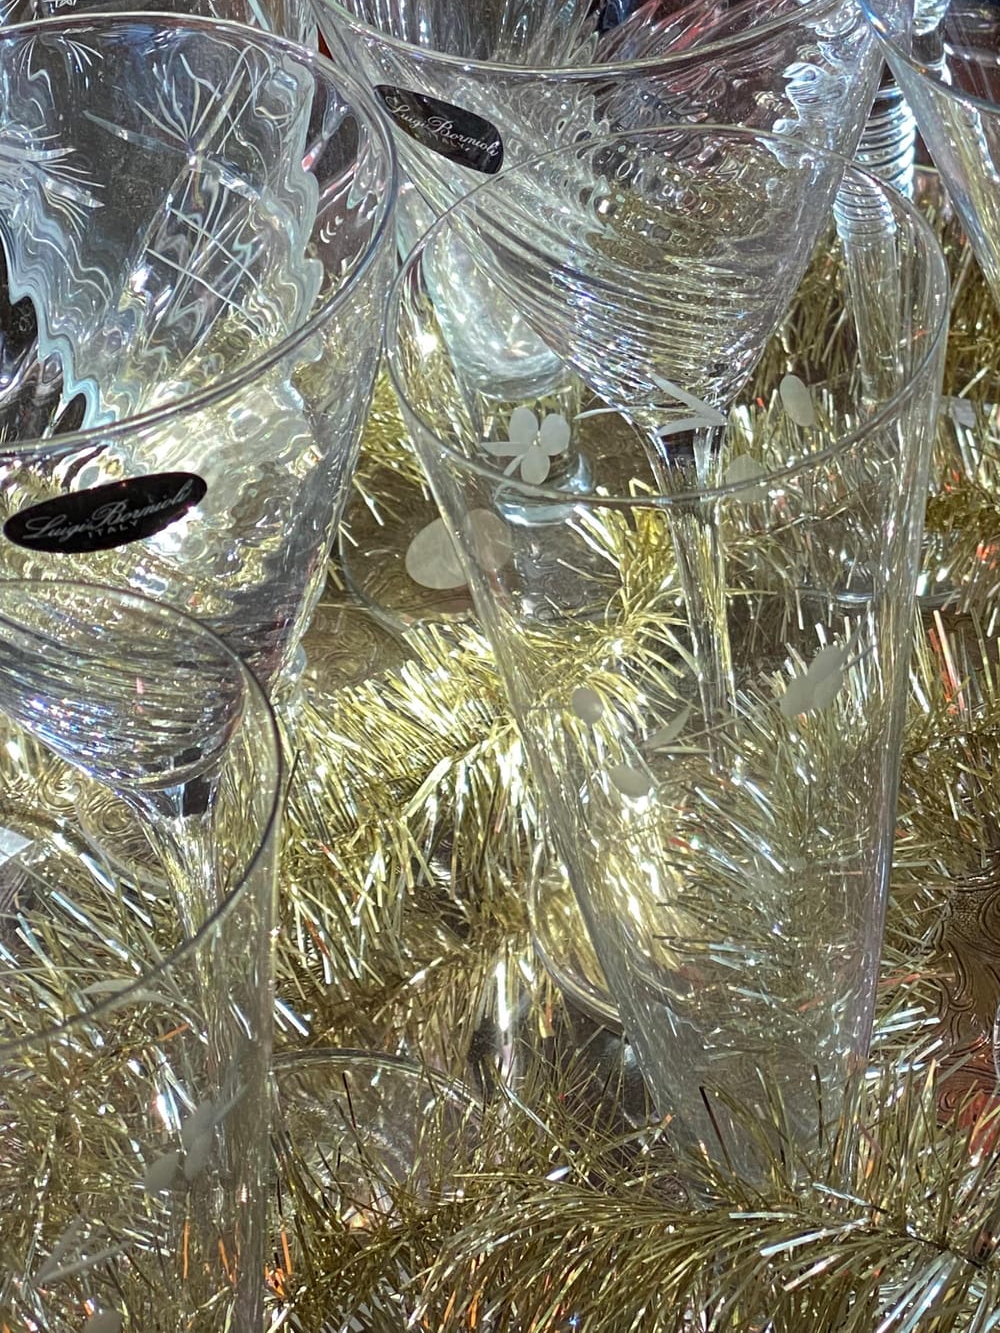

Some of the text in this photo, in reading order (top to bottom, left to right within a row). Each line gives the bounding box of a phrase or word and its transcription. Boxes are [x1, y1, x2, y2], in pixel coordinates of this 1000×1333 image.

[385, 96, 500, 157] Luigi Bormioli
[22, 479, 195, 544] Luigi Bormioli
[87, 520, 139, 539] ITALY
